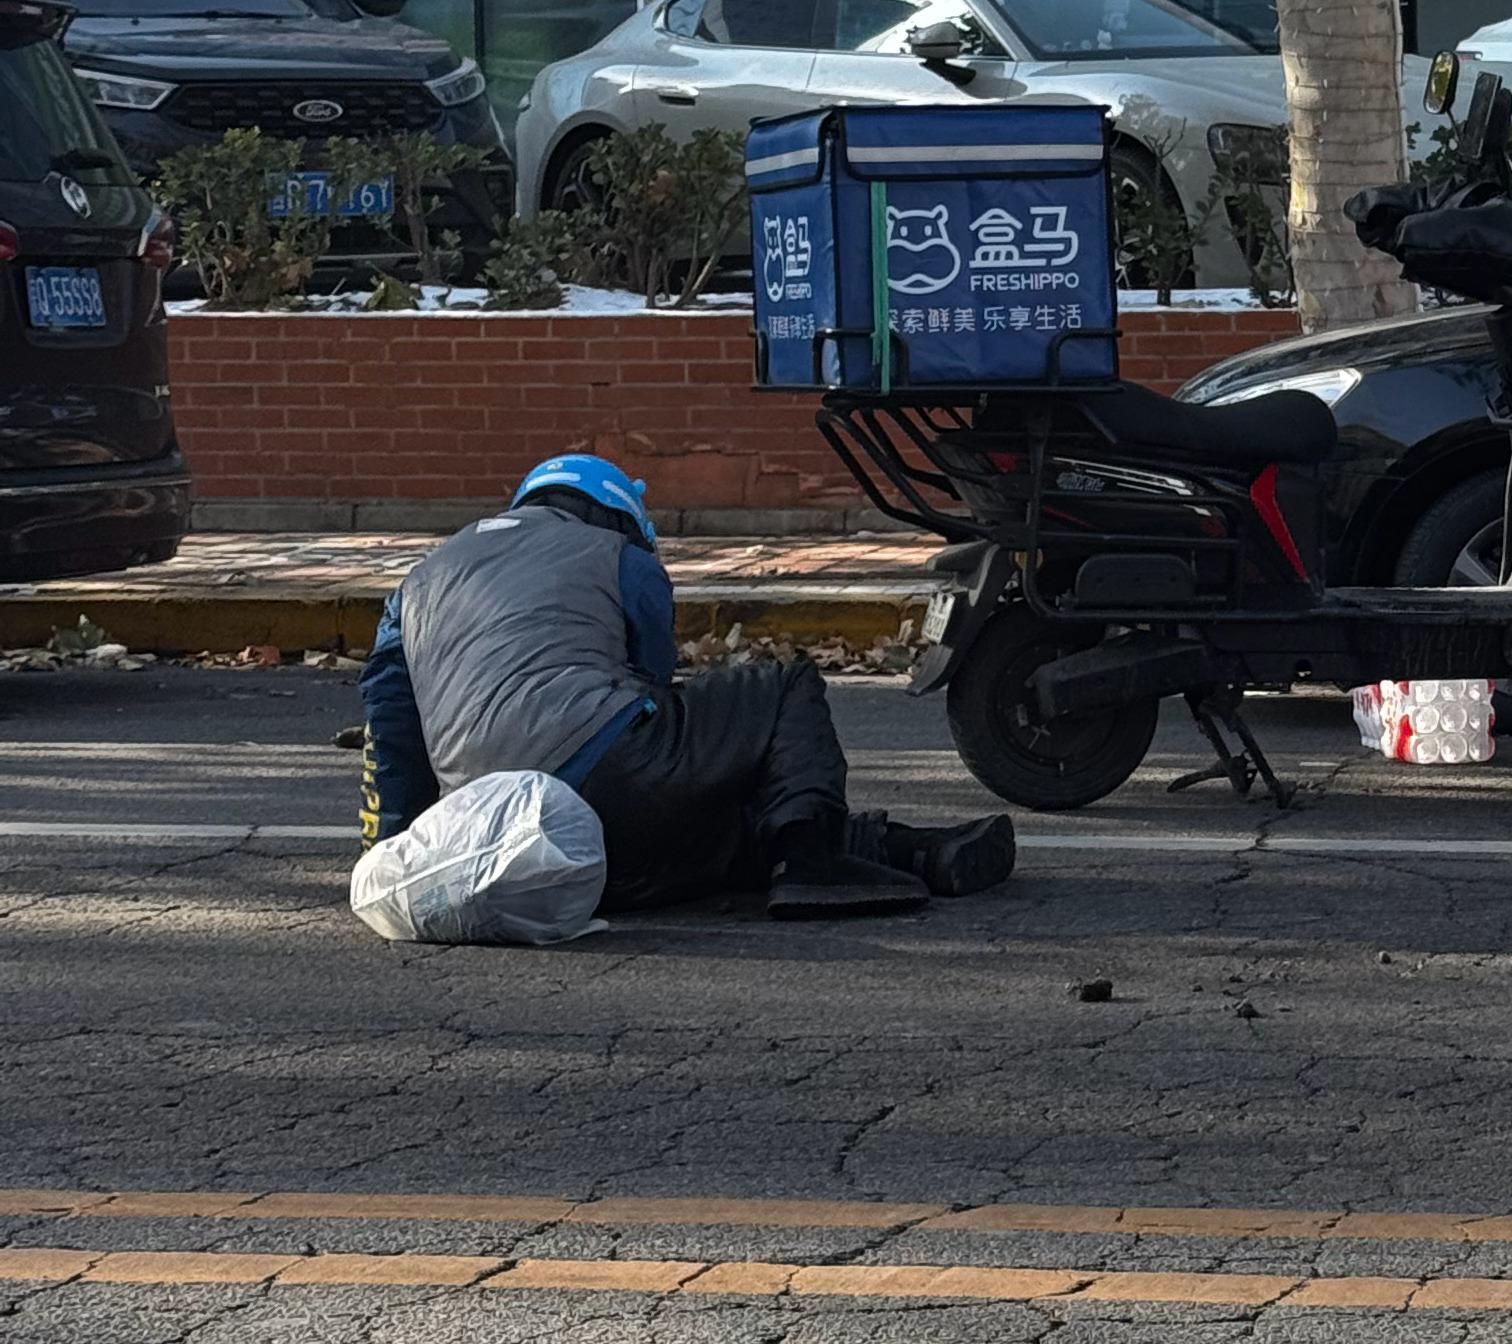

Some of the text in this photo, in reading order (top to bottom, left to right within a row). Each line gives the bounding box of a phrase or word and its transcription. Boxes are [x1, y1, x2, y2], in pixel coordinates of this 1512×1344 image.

[784, 216, 811, 278] 盒马
[968, 205, 1080, 268] 盒马
[969, 272, 1080, 292] FRESHIPPO
[982, 303, 1083, 332] 乐享生活
